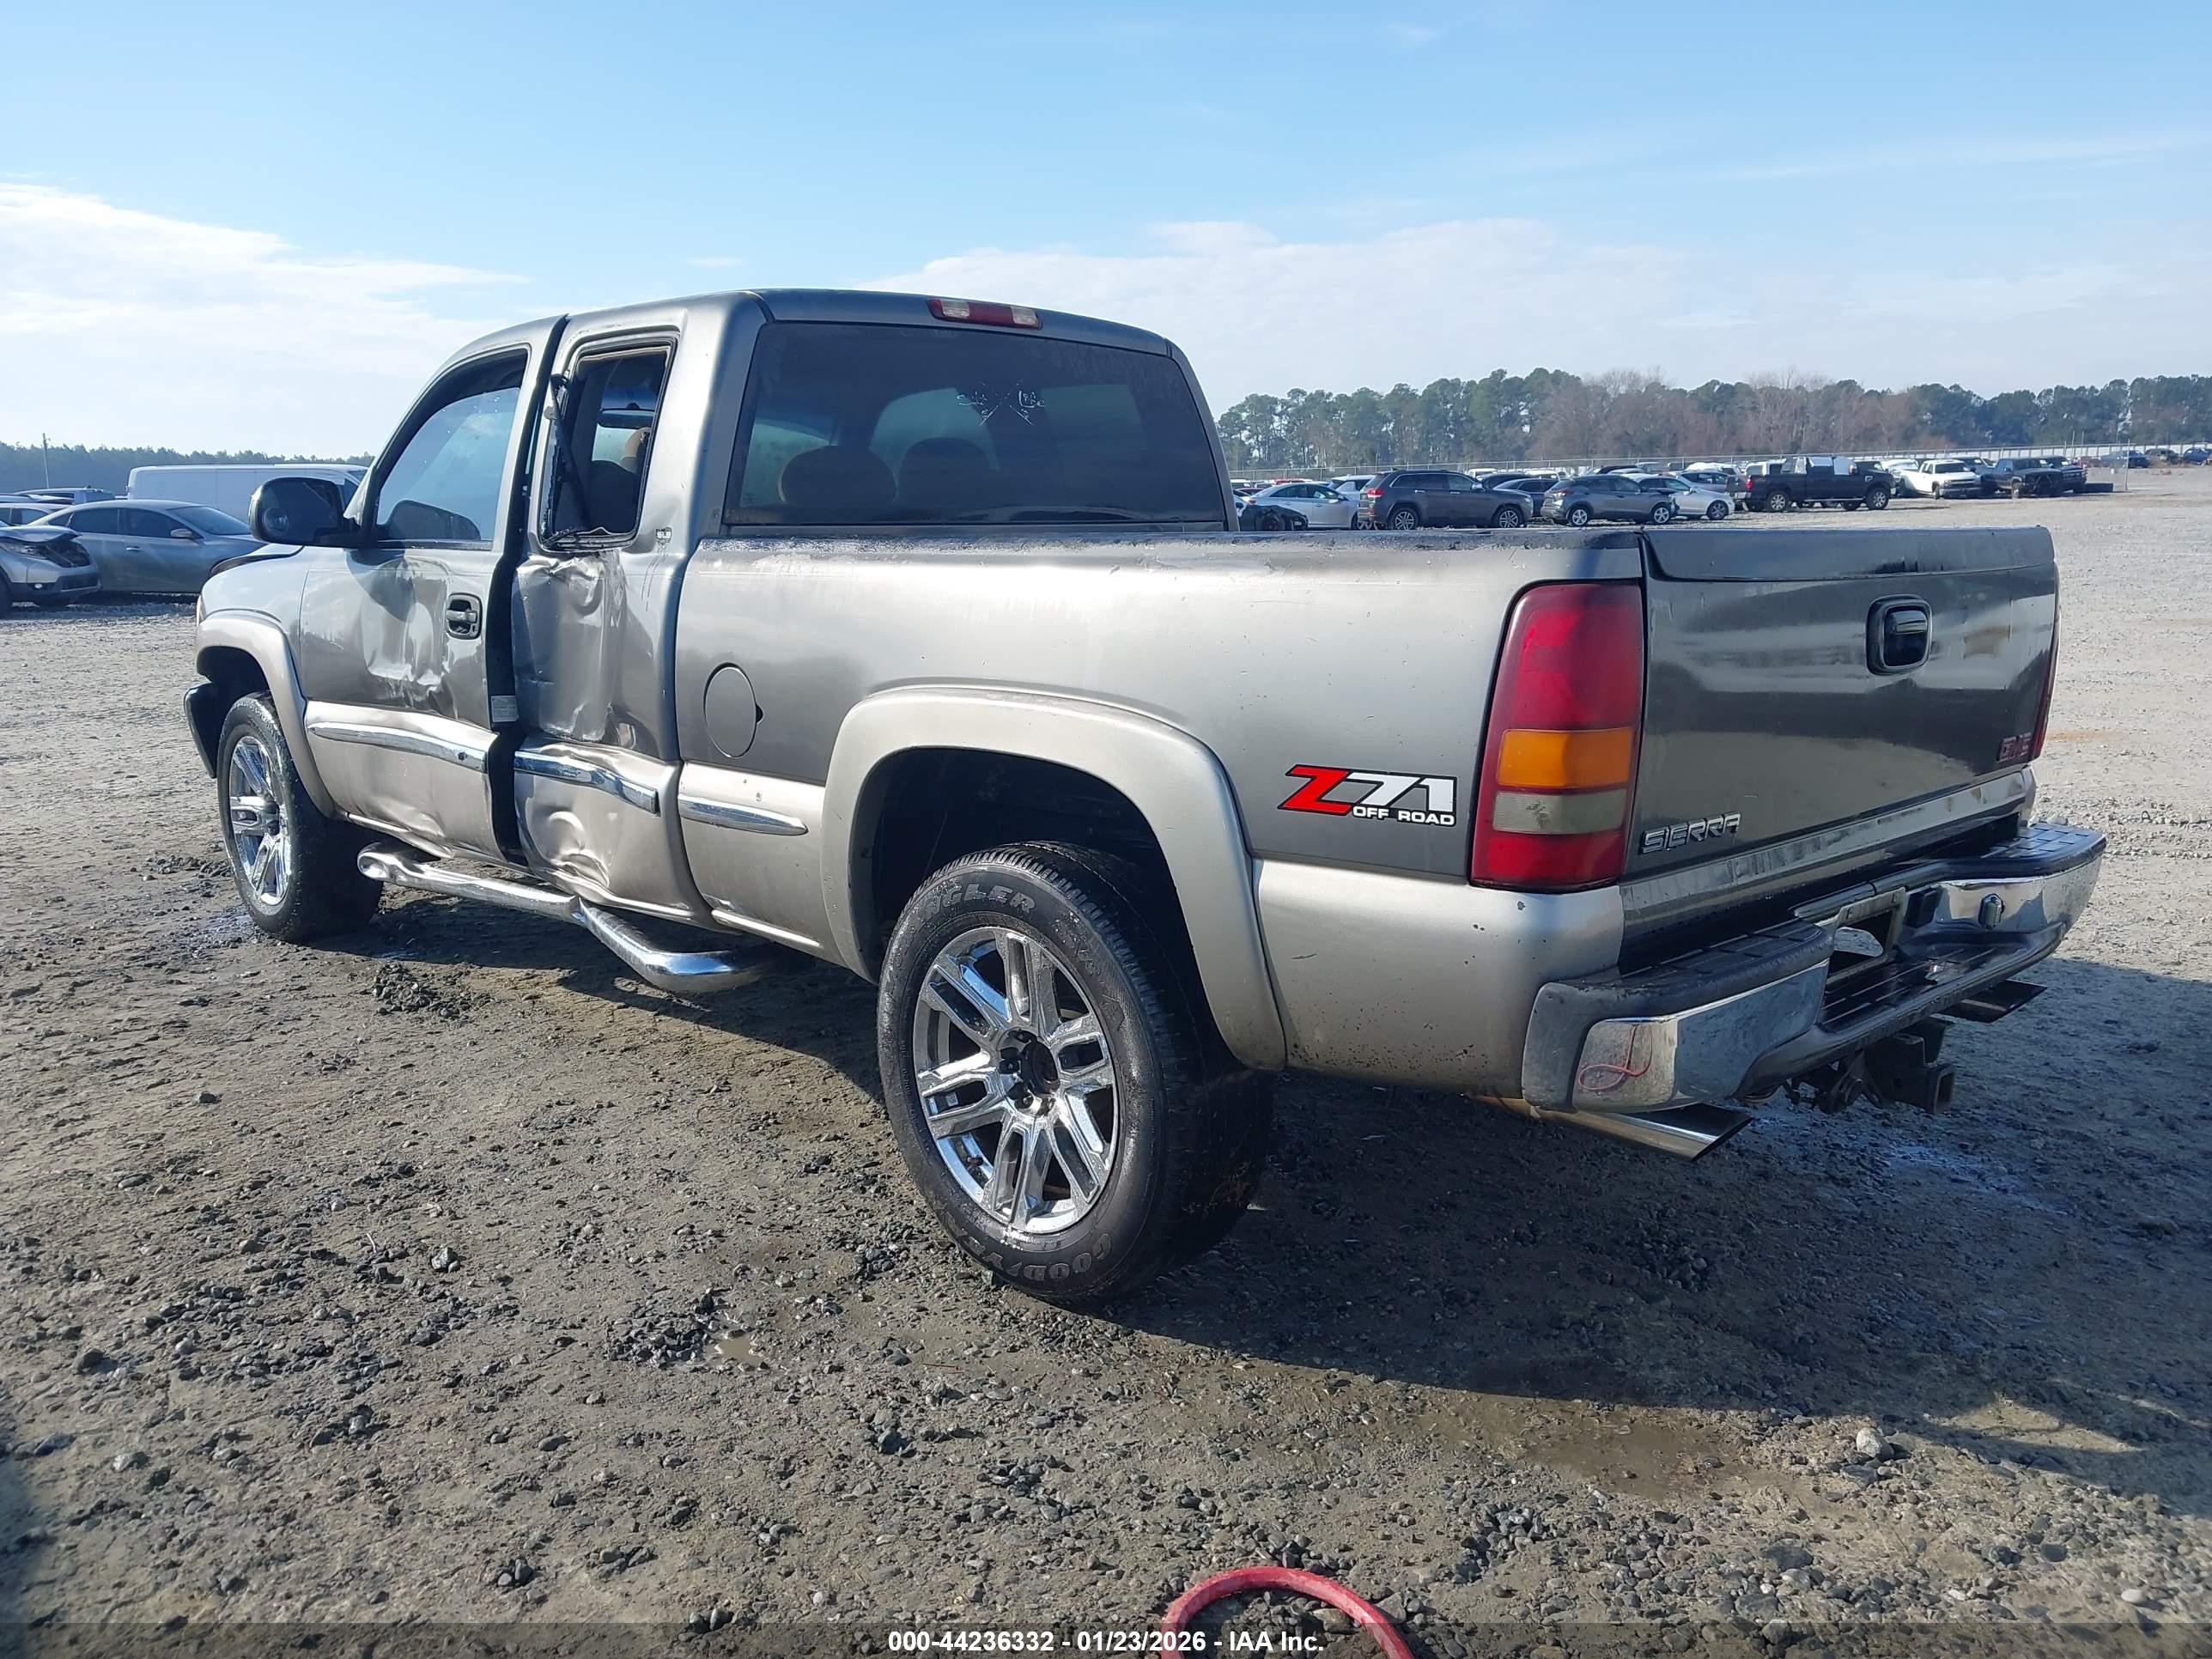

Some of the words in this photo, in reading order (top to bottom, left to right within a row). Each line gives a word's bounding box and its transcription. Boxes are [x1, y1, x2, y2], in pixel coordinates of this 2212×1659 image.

[1278, 763, 1457, 816] Z71
[1352, 805, 1389, 819] OFF
[1397, 810, 1455, 826] ROAD
[1641, 812, 1741, 854] SIERRA
